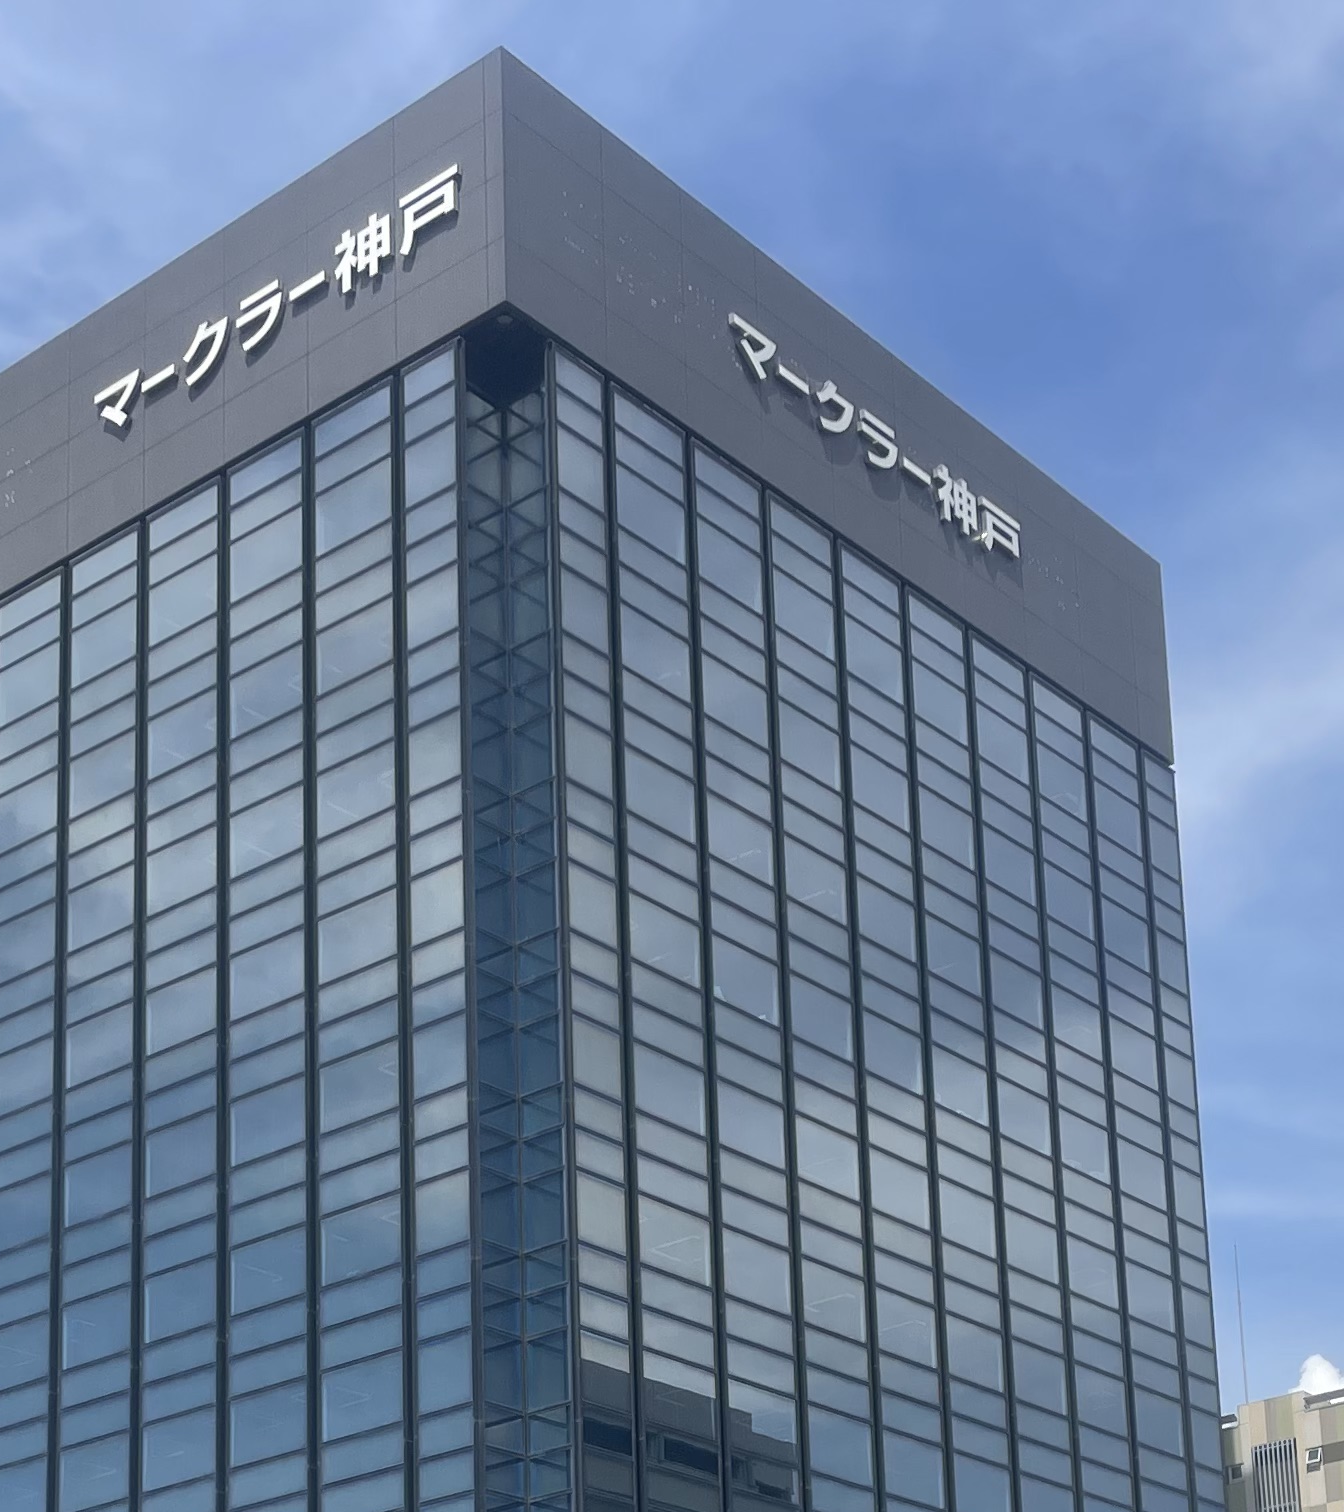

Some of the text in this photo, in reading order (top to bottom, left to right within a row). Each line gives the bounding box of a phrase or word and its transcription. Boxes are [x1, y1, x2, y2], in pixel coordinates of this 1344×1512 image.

[94, 163, 459, 427] マークラー神戸
[728, 312, 1021, 558] マークラー神戸
